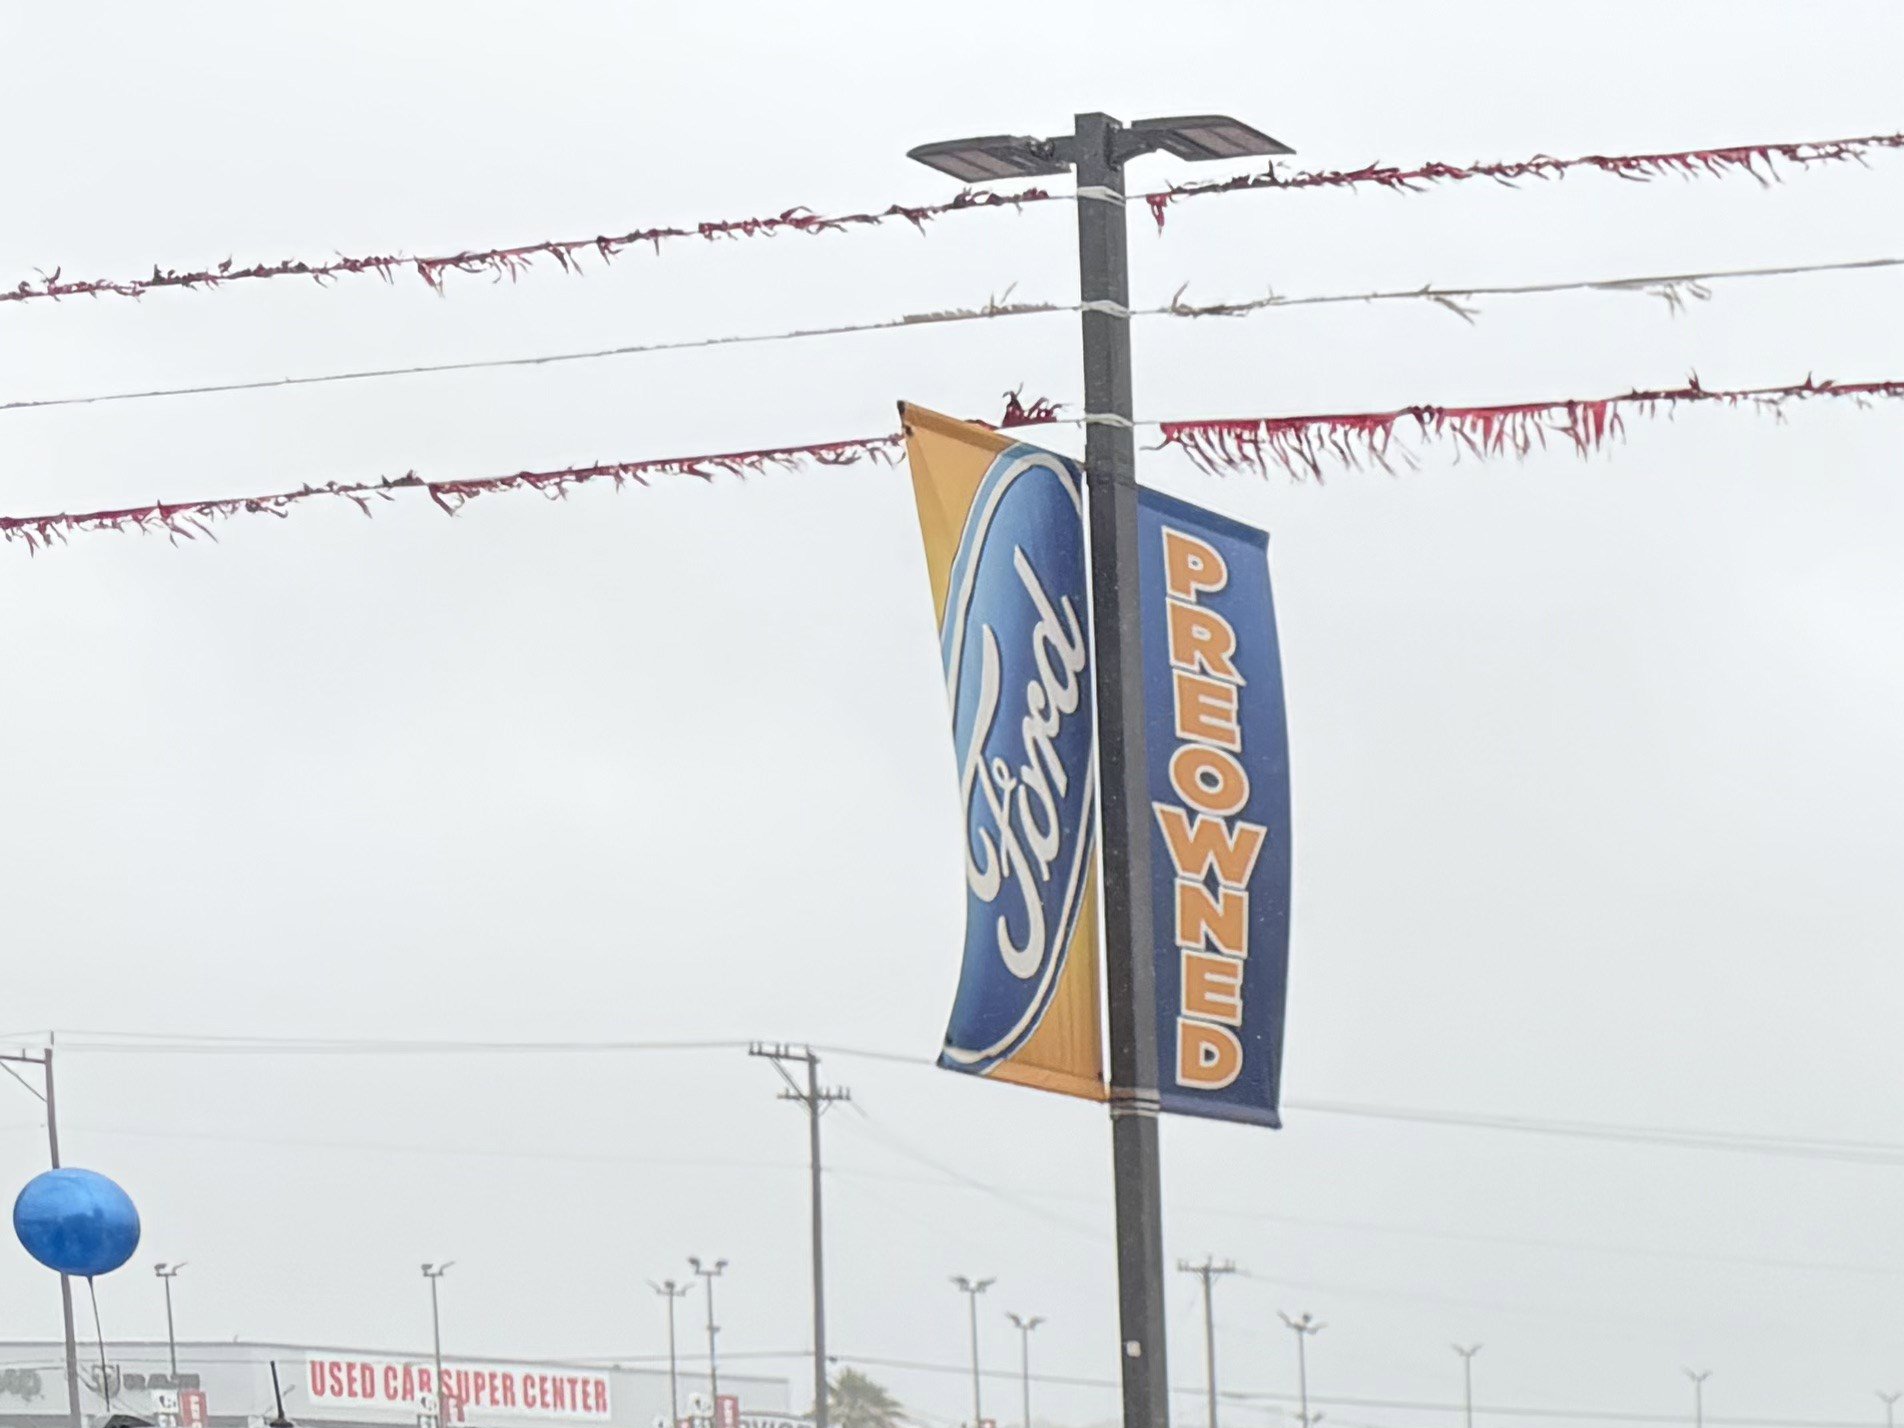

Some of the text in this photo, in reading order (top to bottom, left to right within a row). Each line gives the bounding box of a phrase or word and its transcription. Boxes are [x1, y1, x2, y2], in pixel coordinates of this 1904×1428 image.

[959, 546, 1087, 981] Ford
[1152, 526, 1268, 1091] PREOWNED
[310, 1360, 608, 1413] USED CAR SUPER CENTER
